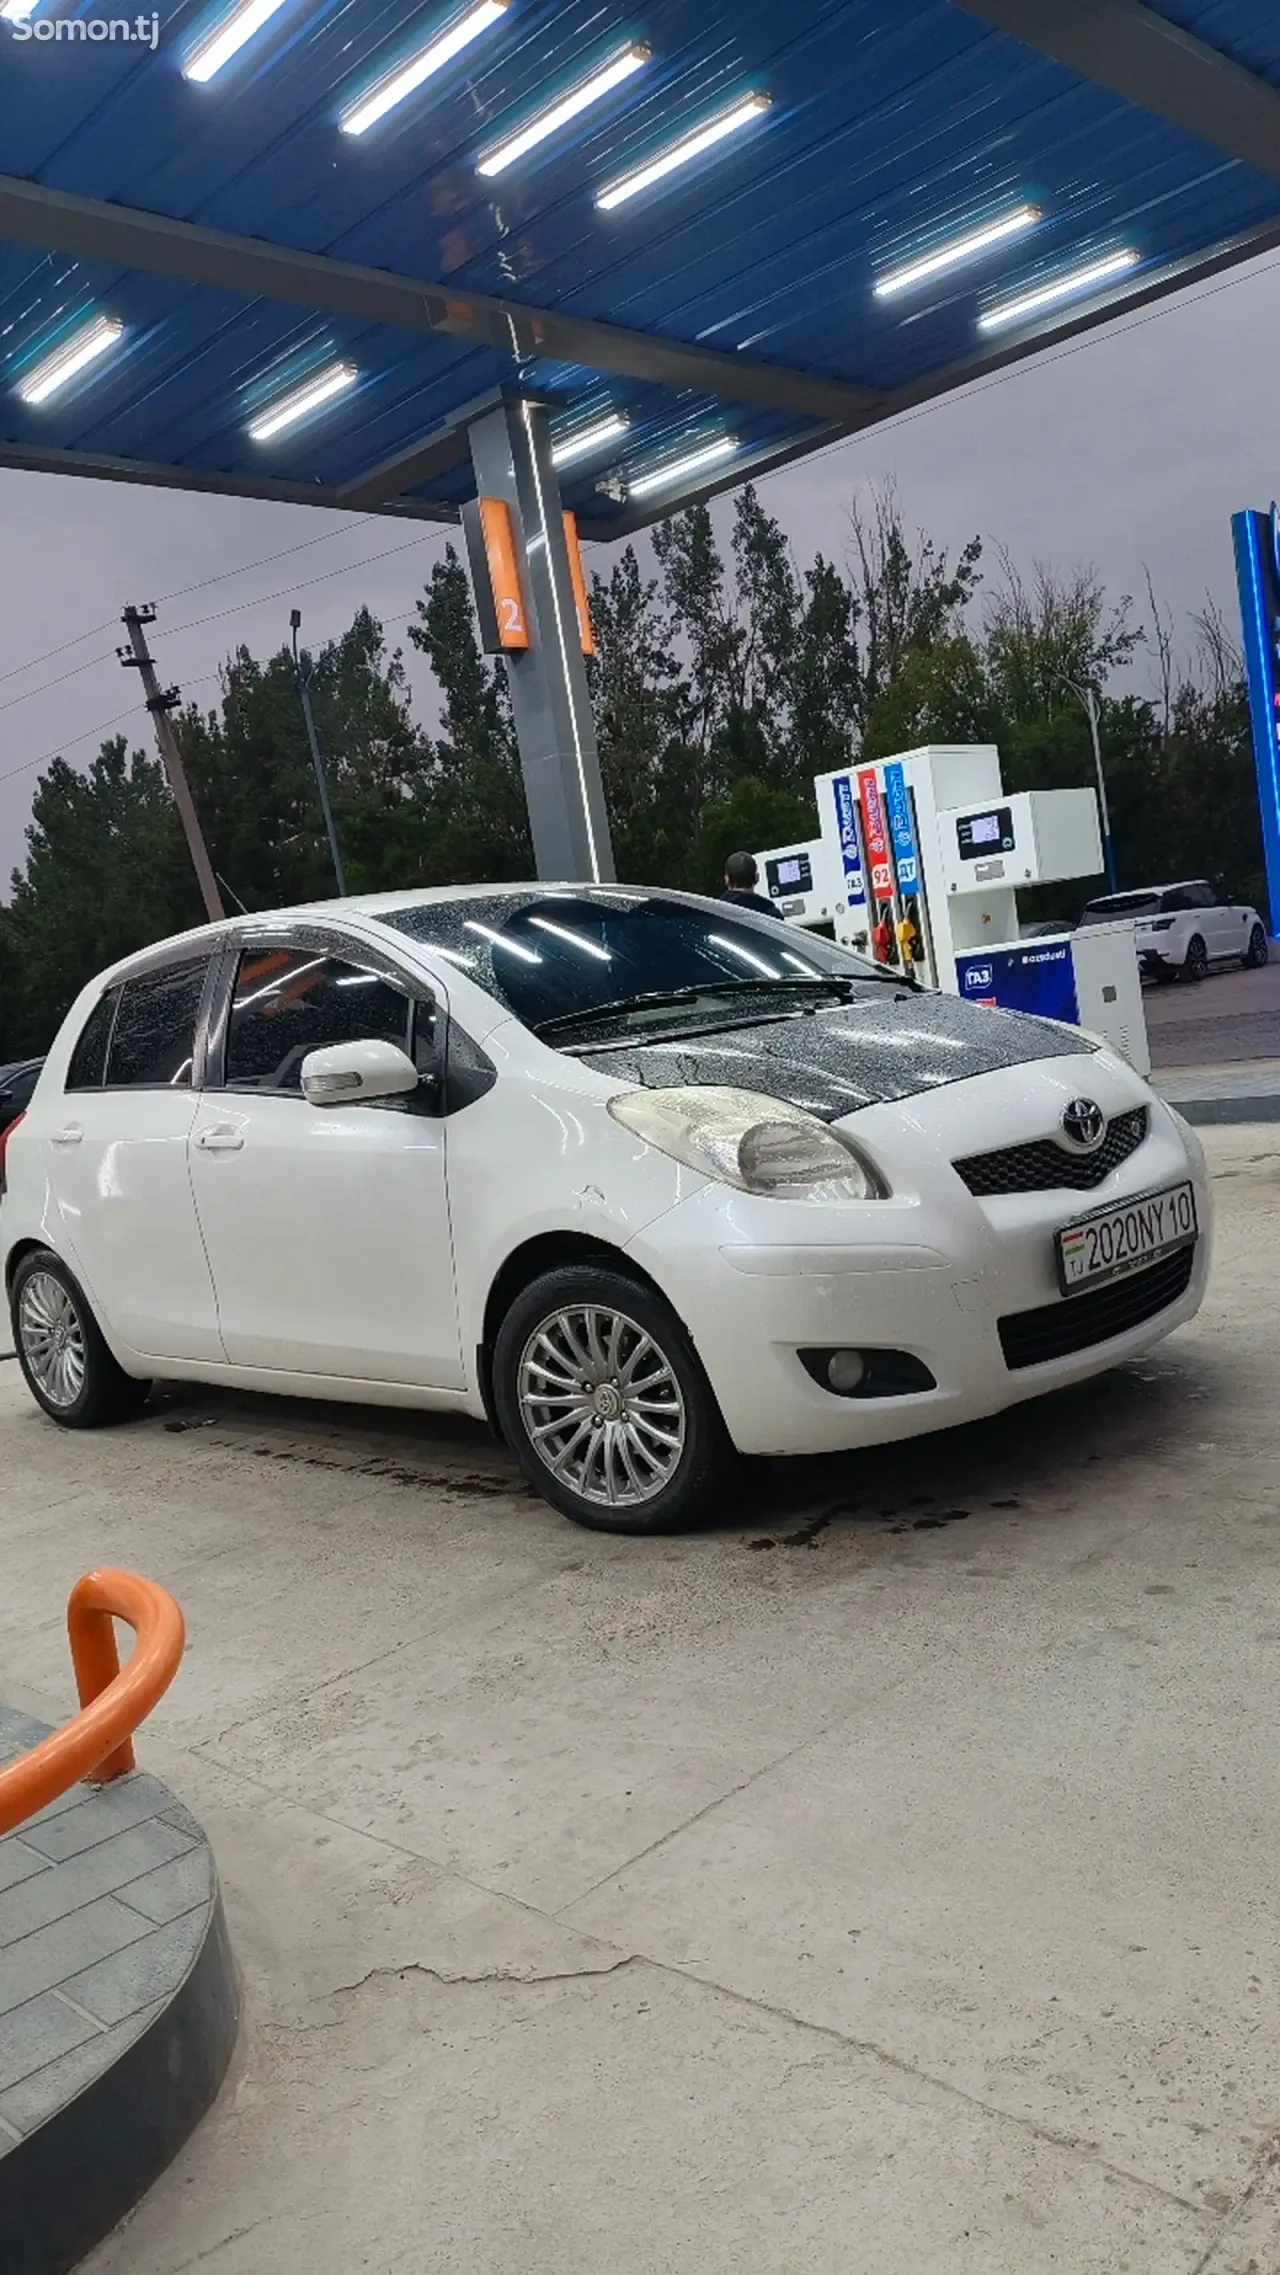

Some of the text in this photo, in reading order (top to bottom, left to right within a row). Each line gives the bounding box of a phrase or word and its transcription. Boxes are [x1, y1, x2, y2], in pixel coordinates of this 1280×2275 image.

[500, 598, 523, 632] 2
[874, 868, 890, 884] 92
[966, 969, 990, 986] ГАЗ
[1085, 1200, 1164, 1271] 2020NY
[1168, 1191, 1191, 1235] 10
[1069, 1259, 1084, 1277] TJ
